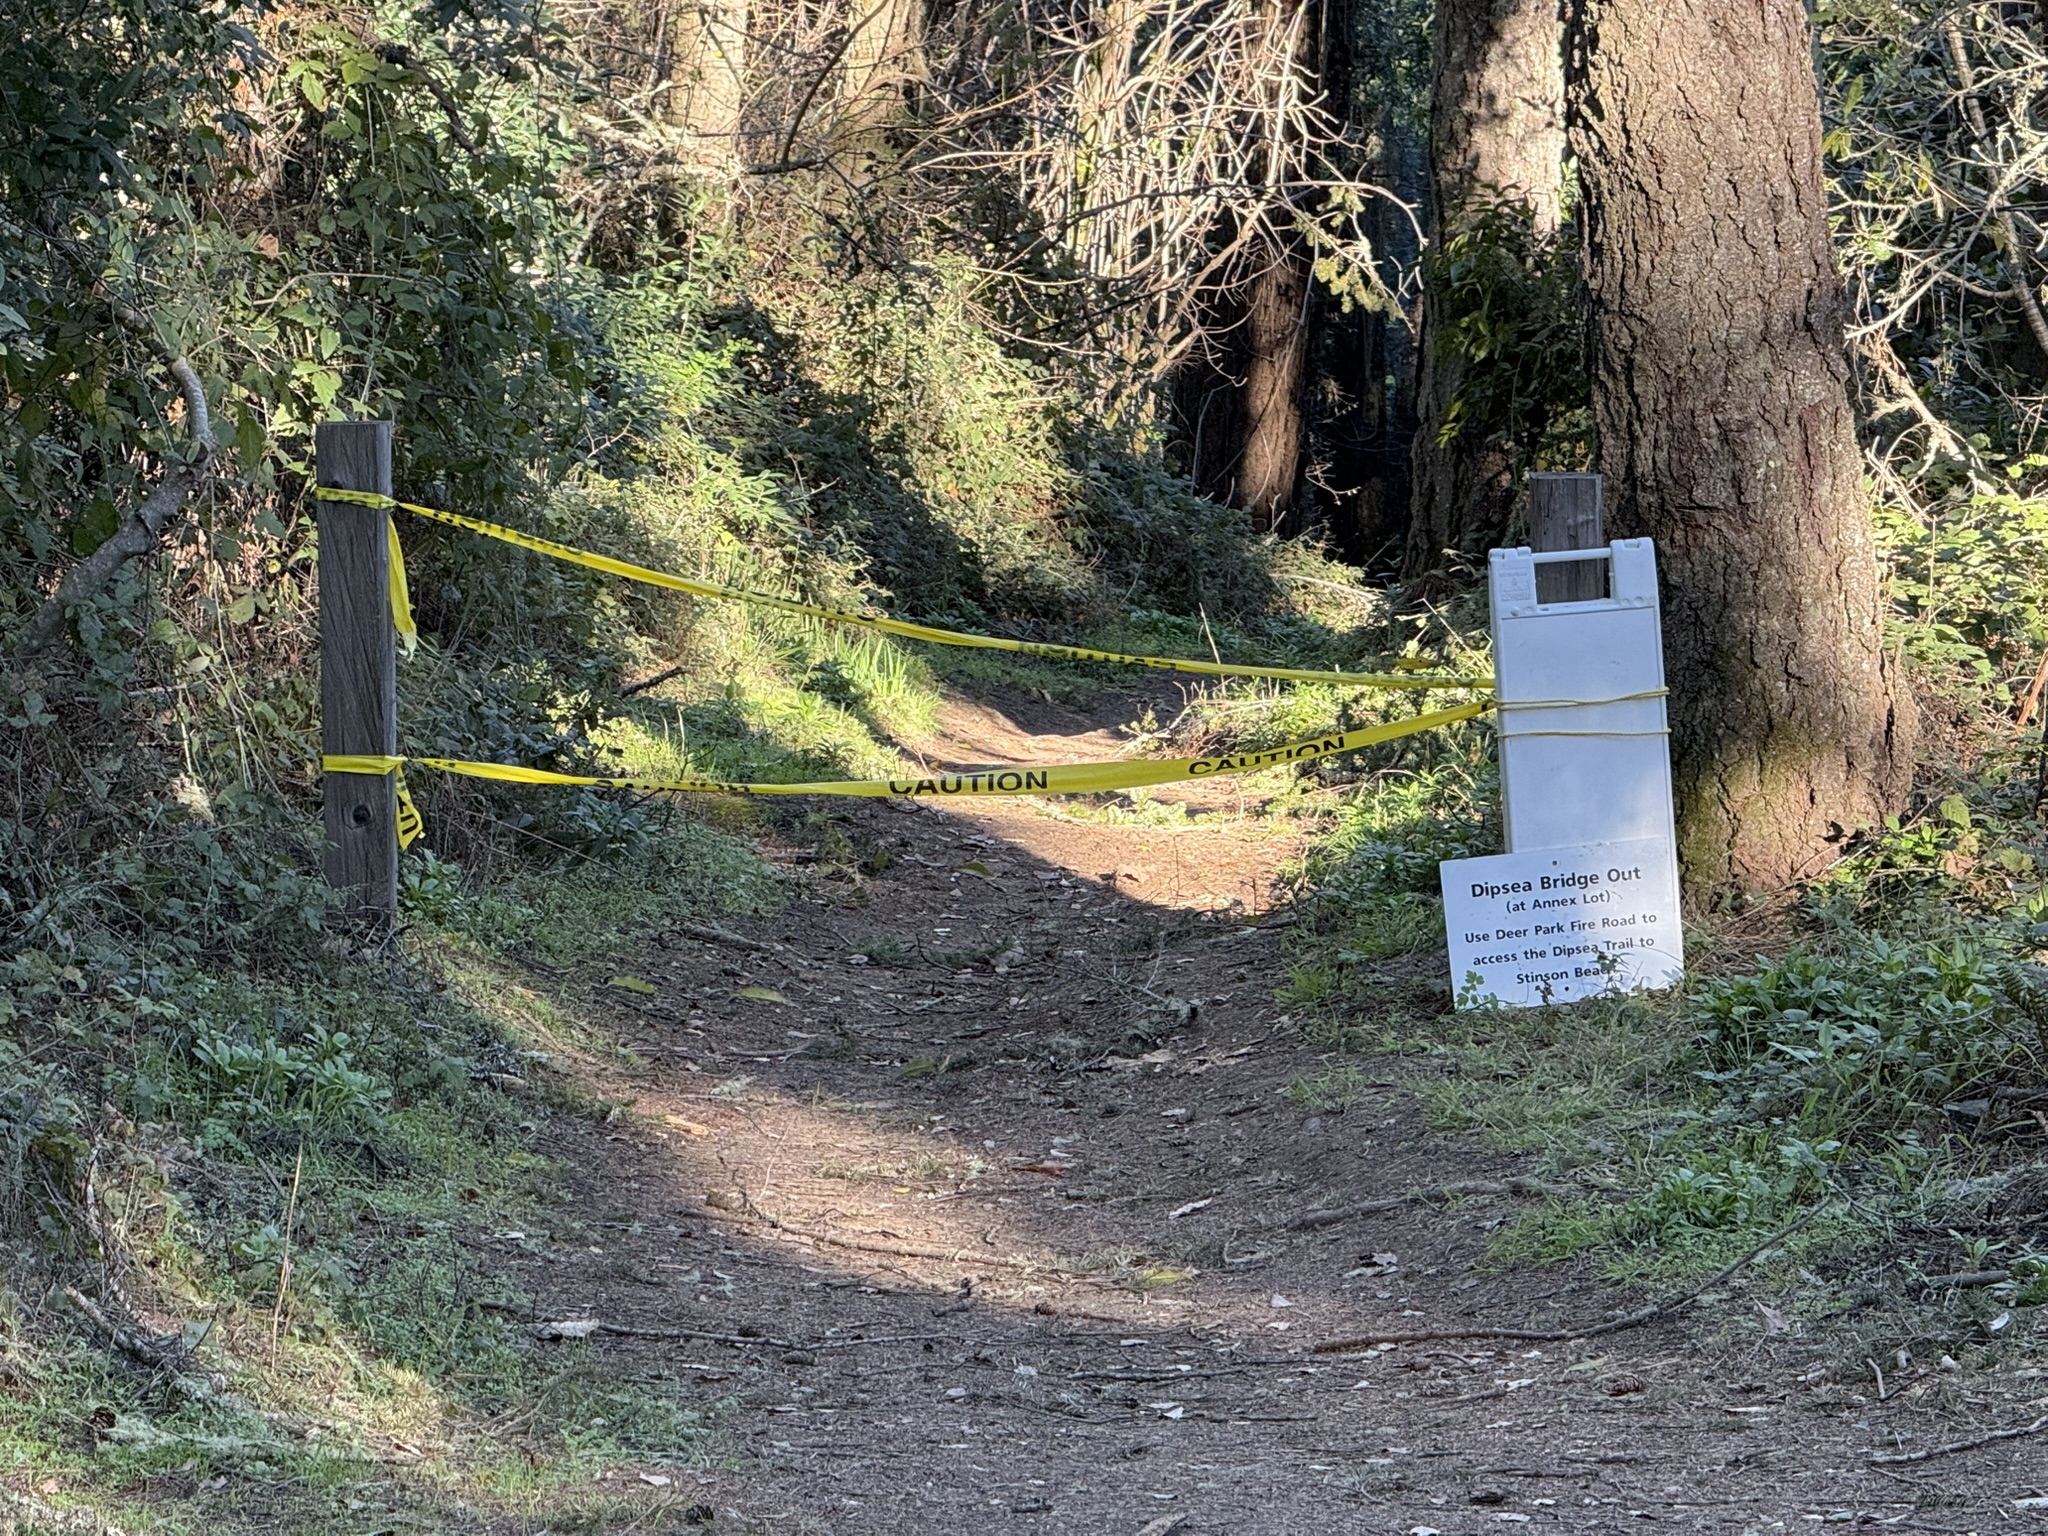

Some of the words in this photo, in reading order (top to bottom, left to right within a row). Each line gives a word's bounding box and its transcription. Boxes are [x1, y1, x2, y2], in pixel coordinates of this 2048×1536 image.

[1188, 736, 1345, 775] CAUTION
[888, 771, 1048, 795] CAUTION
[1471, 880, 1533, 899] Dipsea
[1540, 871, 1600, 890] Bridge
[1607, 866, 1642, 883] Out
[1506, 900, 1526, 914] (at
[1532, 896, 1577, 911] Annex
[1583, 889, 1611, 905] Lot)
[1465, 931, 1490, 944] Use
[1496, 927, 1529, 941] Deer
[1534, 922, 1565, 936] Park
[1571, 919, 1596, 932] Fire
[1602, 913, 1636, 928] Road
[1642, 912, 1657, 924] to
[1473, 952, 1518, 967] access
[1523, 948, 1547, 961] the
[1553, 942, 1599, 959] Dipsea
[1605, 937, 1633, 951] Trail
[1639, 936, 1655, 948] to
[1516, 969, 1569, 985] Stinson
[1574, 965, 1616, 979] Beac
